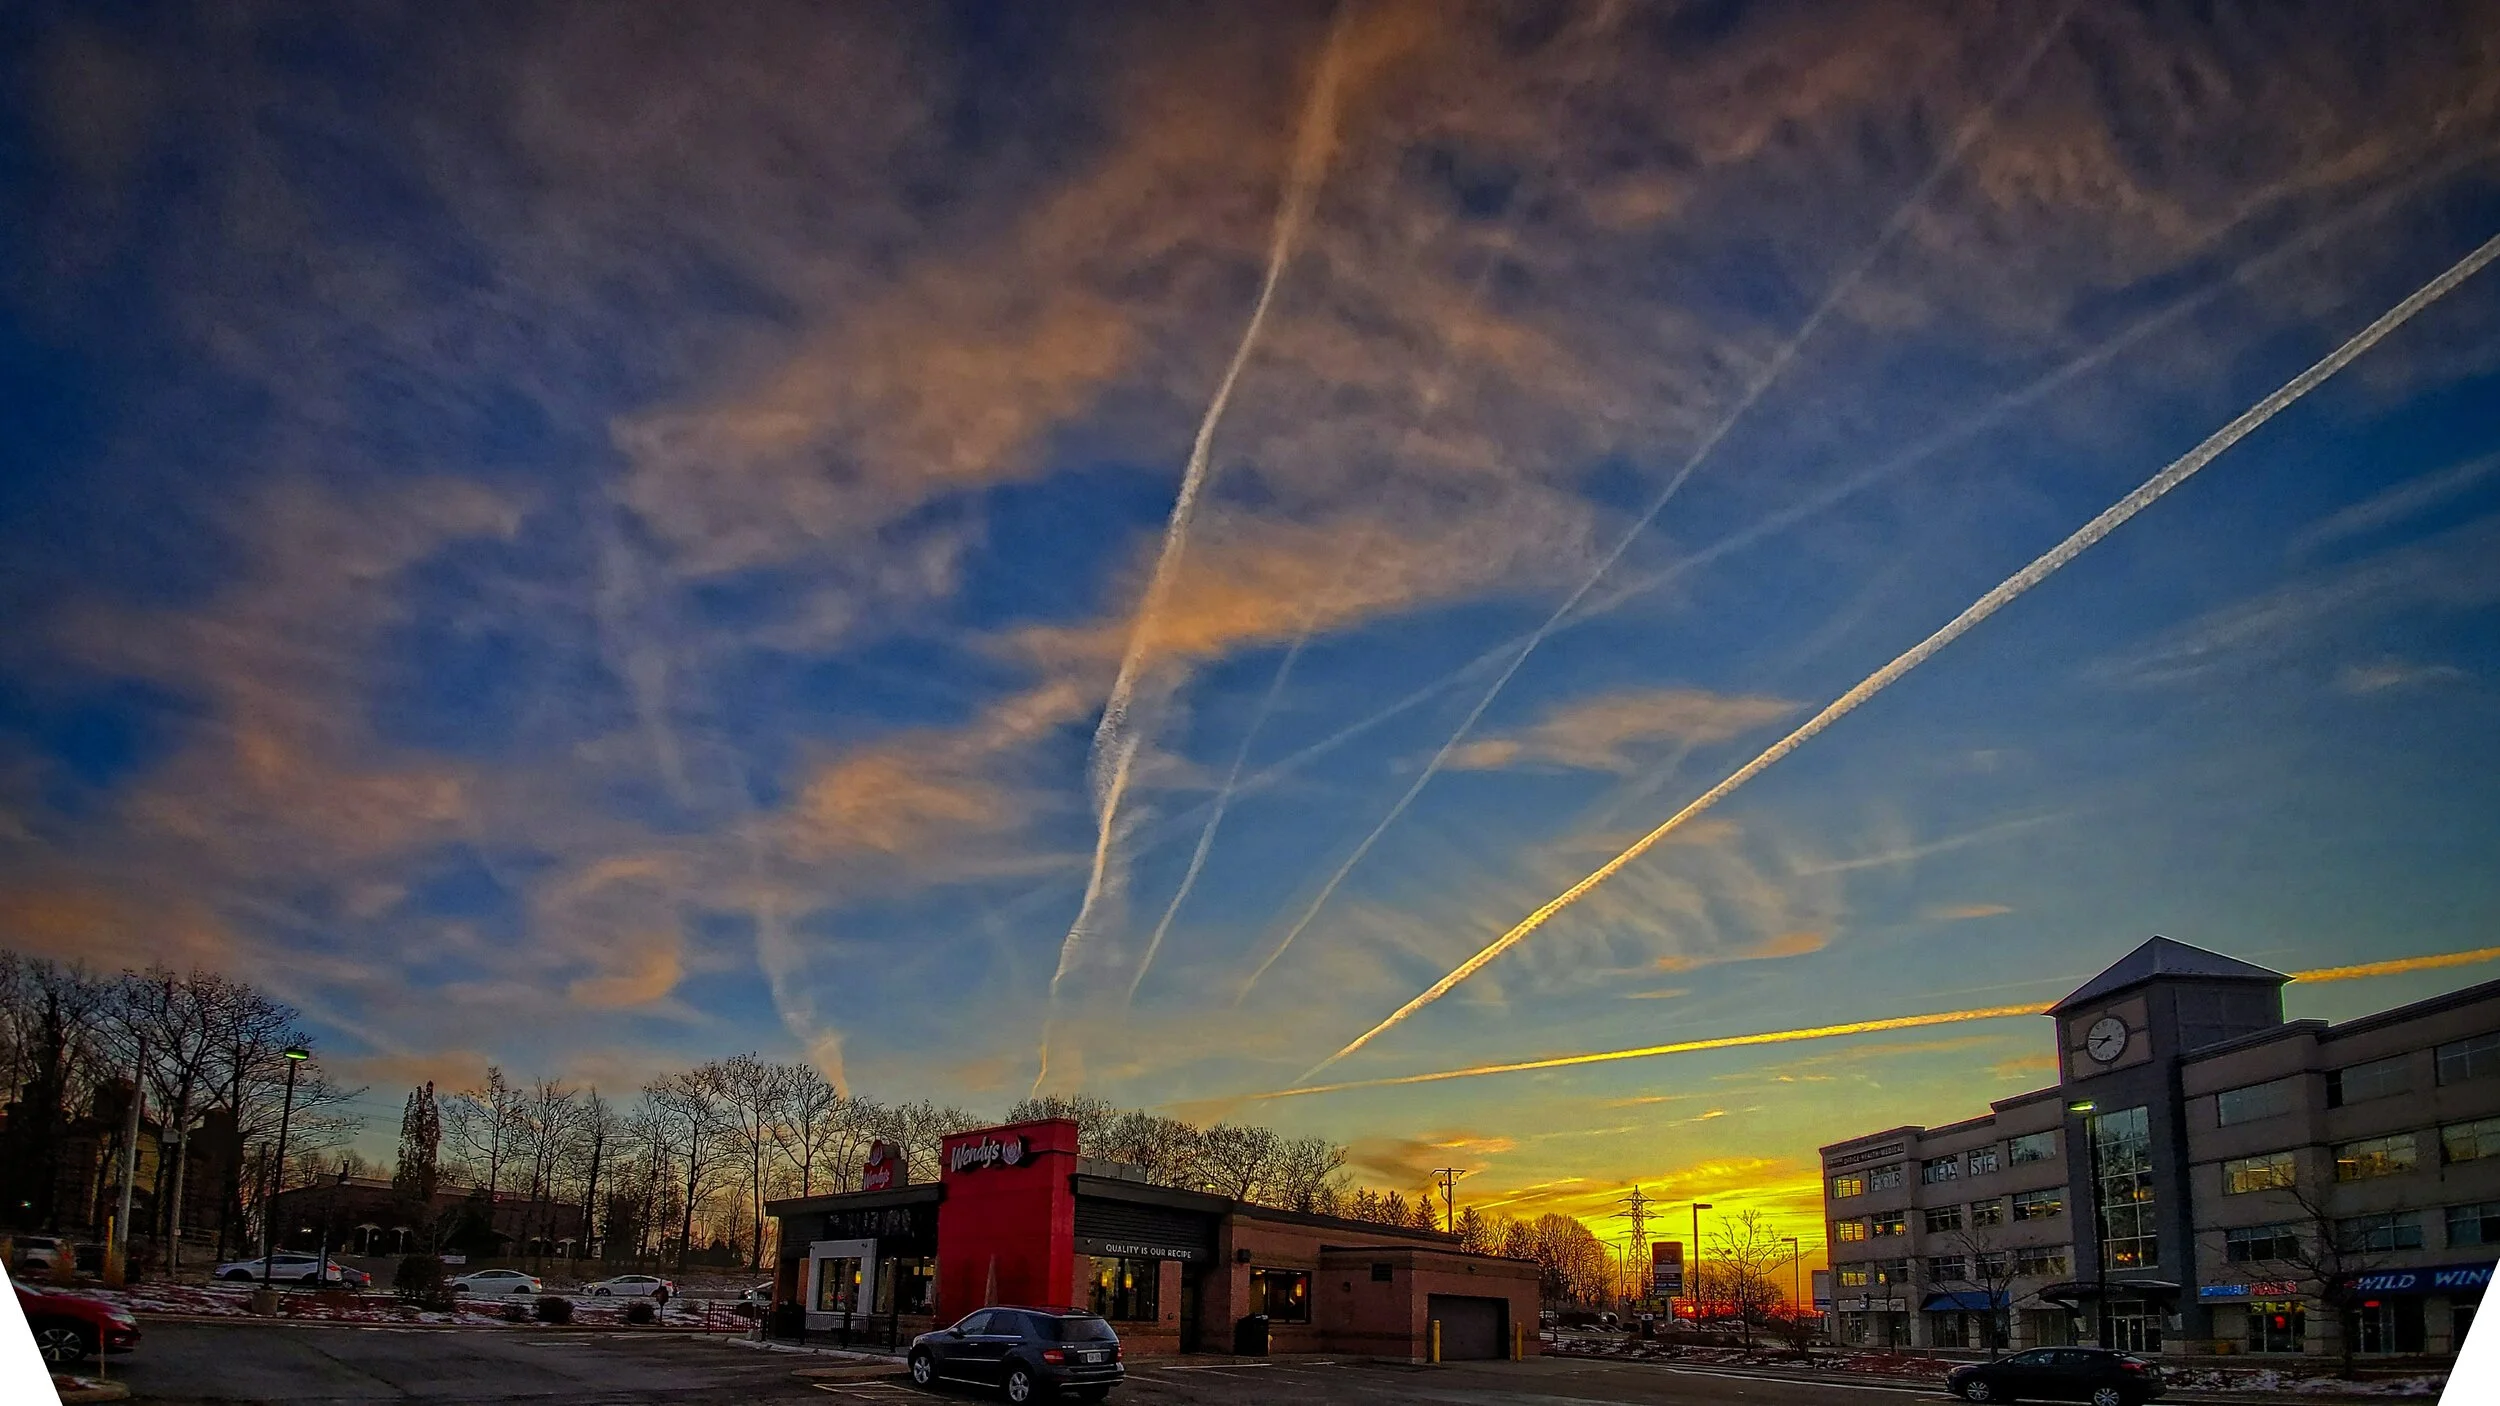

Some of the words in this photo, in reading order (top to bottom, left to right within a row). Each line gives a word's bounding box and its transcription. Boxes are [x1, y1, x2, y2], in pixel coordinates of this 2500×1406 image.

[951, 1136, 999, 1172] Wendy's
[863, 1166, 890, 1190] Wendy's
[1872, 1171, 1901, 1191] FOR
[1105, 1243, 1139, 1254] QUALITY
[1141, 1247, 1148, 1255] IS
[1150, 1248, 1166, 1257] OUR
[1167, 1249, 1192, 1259] RECIPE
[2356, 1274, 2417, 1290] WILD
[2434, 1269, 2493, 1287] WIN
